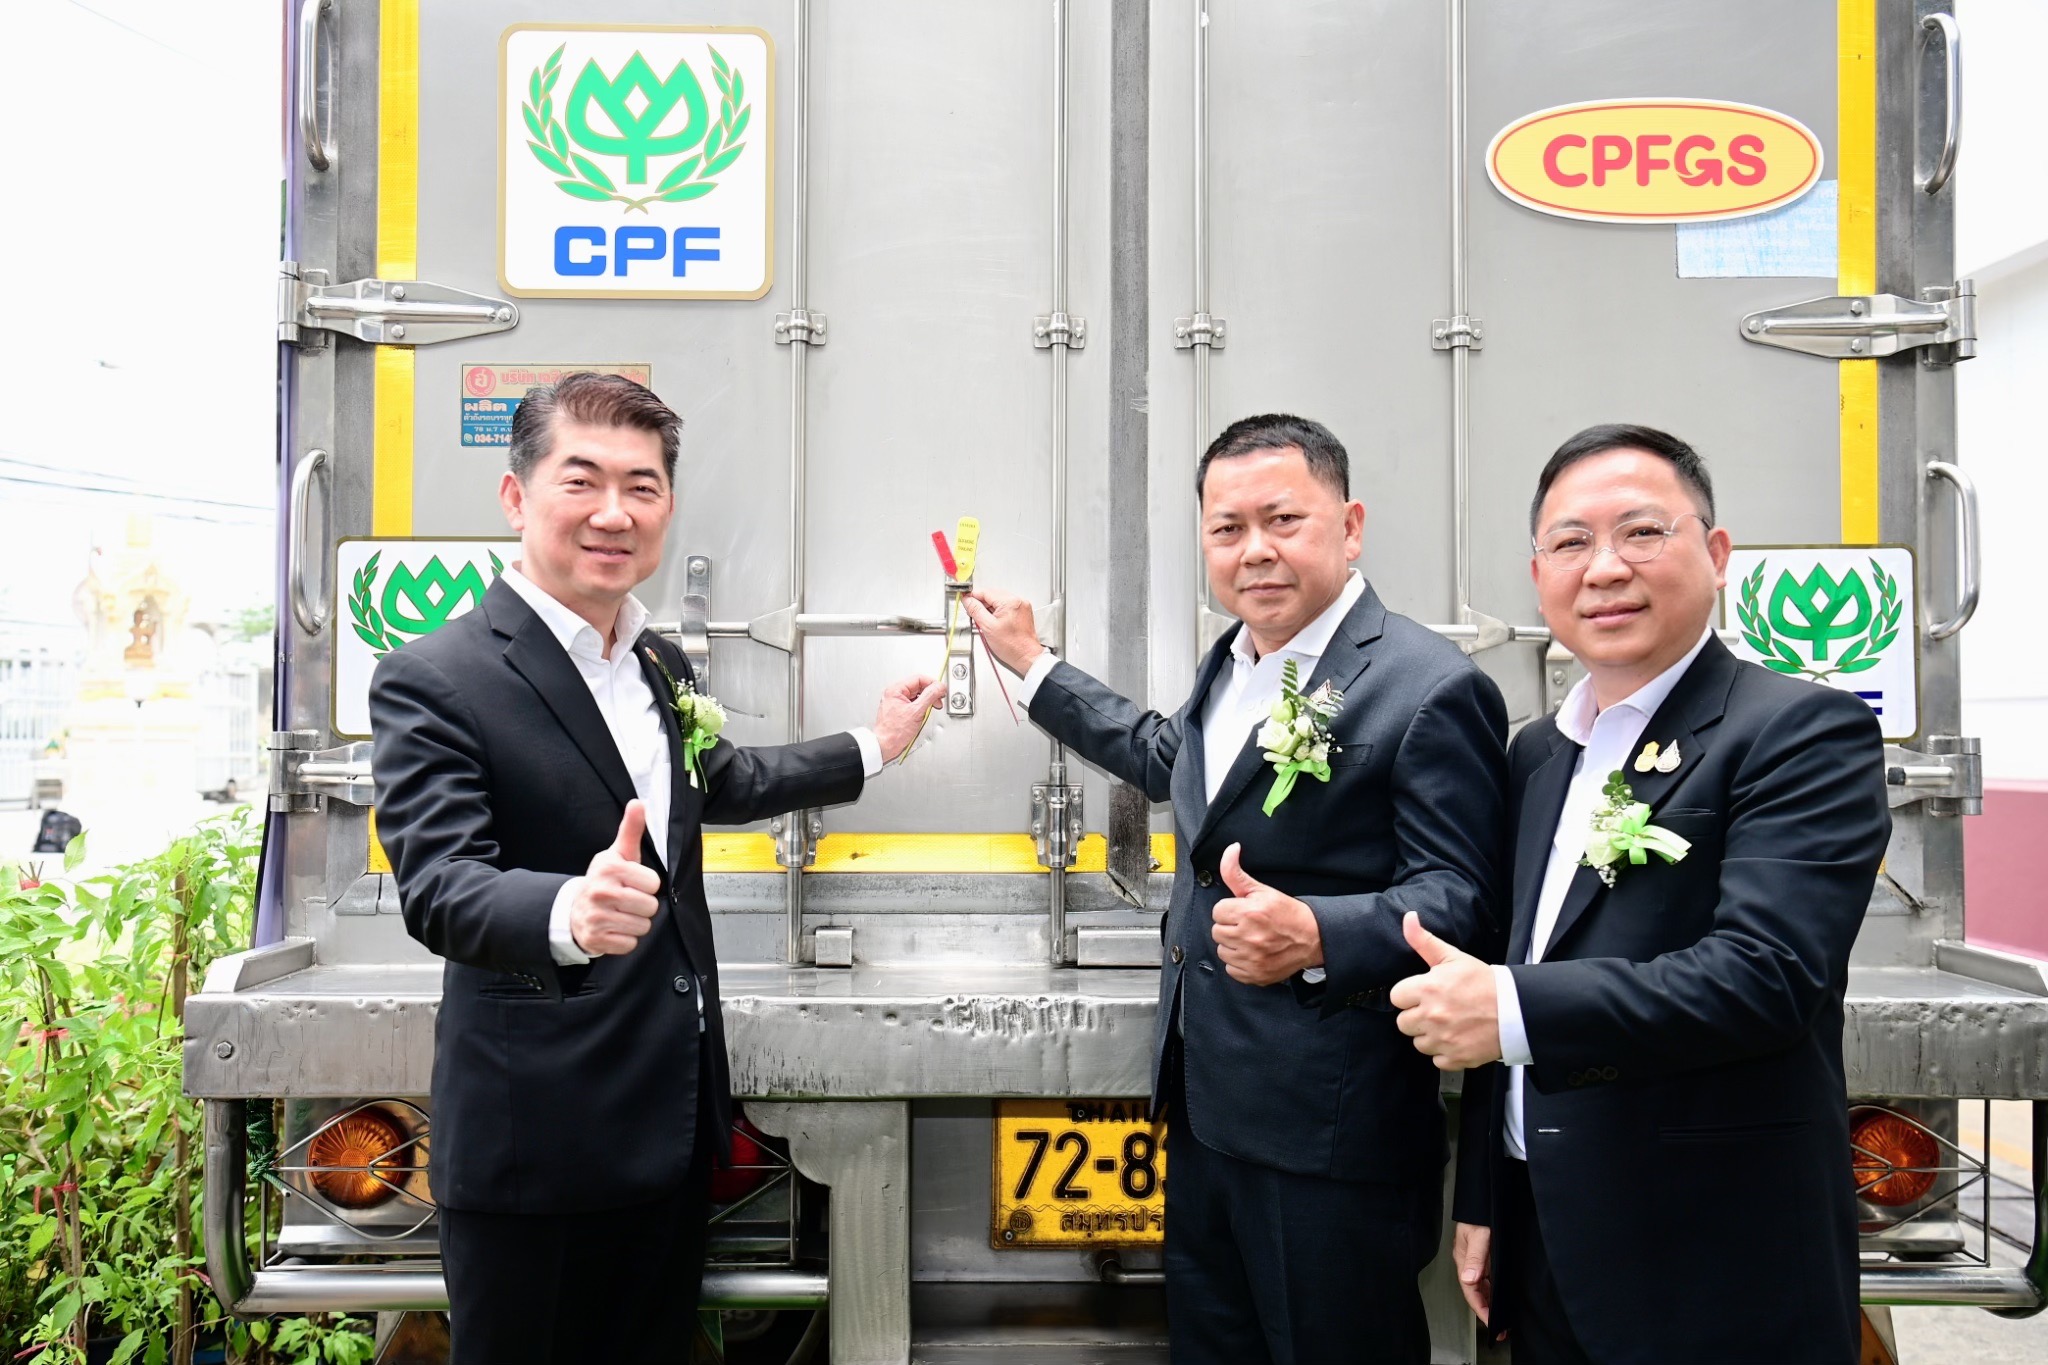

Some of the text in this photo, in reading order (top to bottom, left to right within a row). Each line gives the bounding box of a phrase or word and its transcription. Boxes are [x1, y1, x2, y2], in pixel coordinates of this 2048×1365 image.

[1543, 134, 1766, 187] CPFGS
[554, 225, 720, 277] CPF
[501, 369, 535, 384] บริษัท
[464, 399, 507, 412] ผลิต
[474, 434, 513, 443] 034-714
[1014, 1131, 1168, 1200] 72-8
[1061, 1207, 1164, 1238] สมุทรปร
